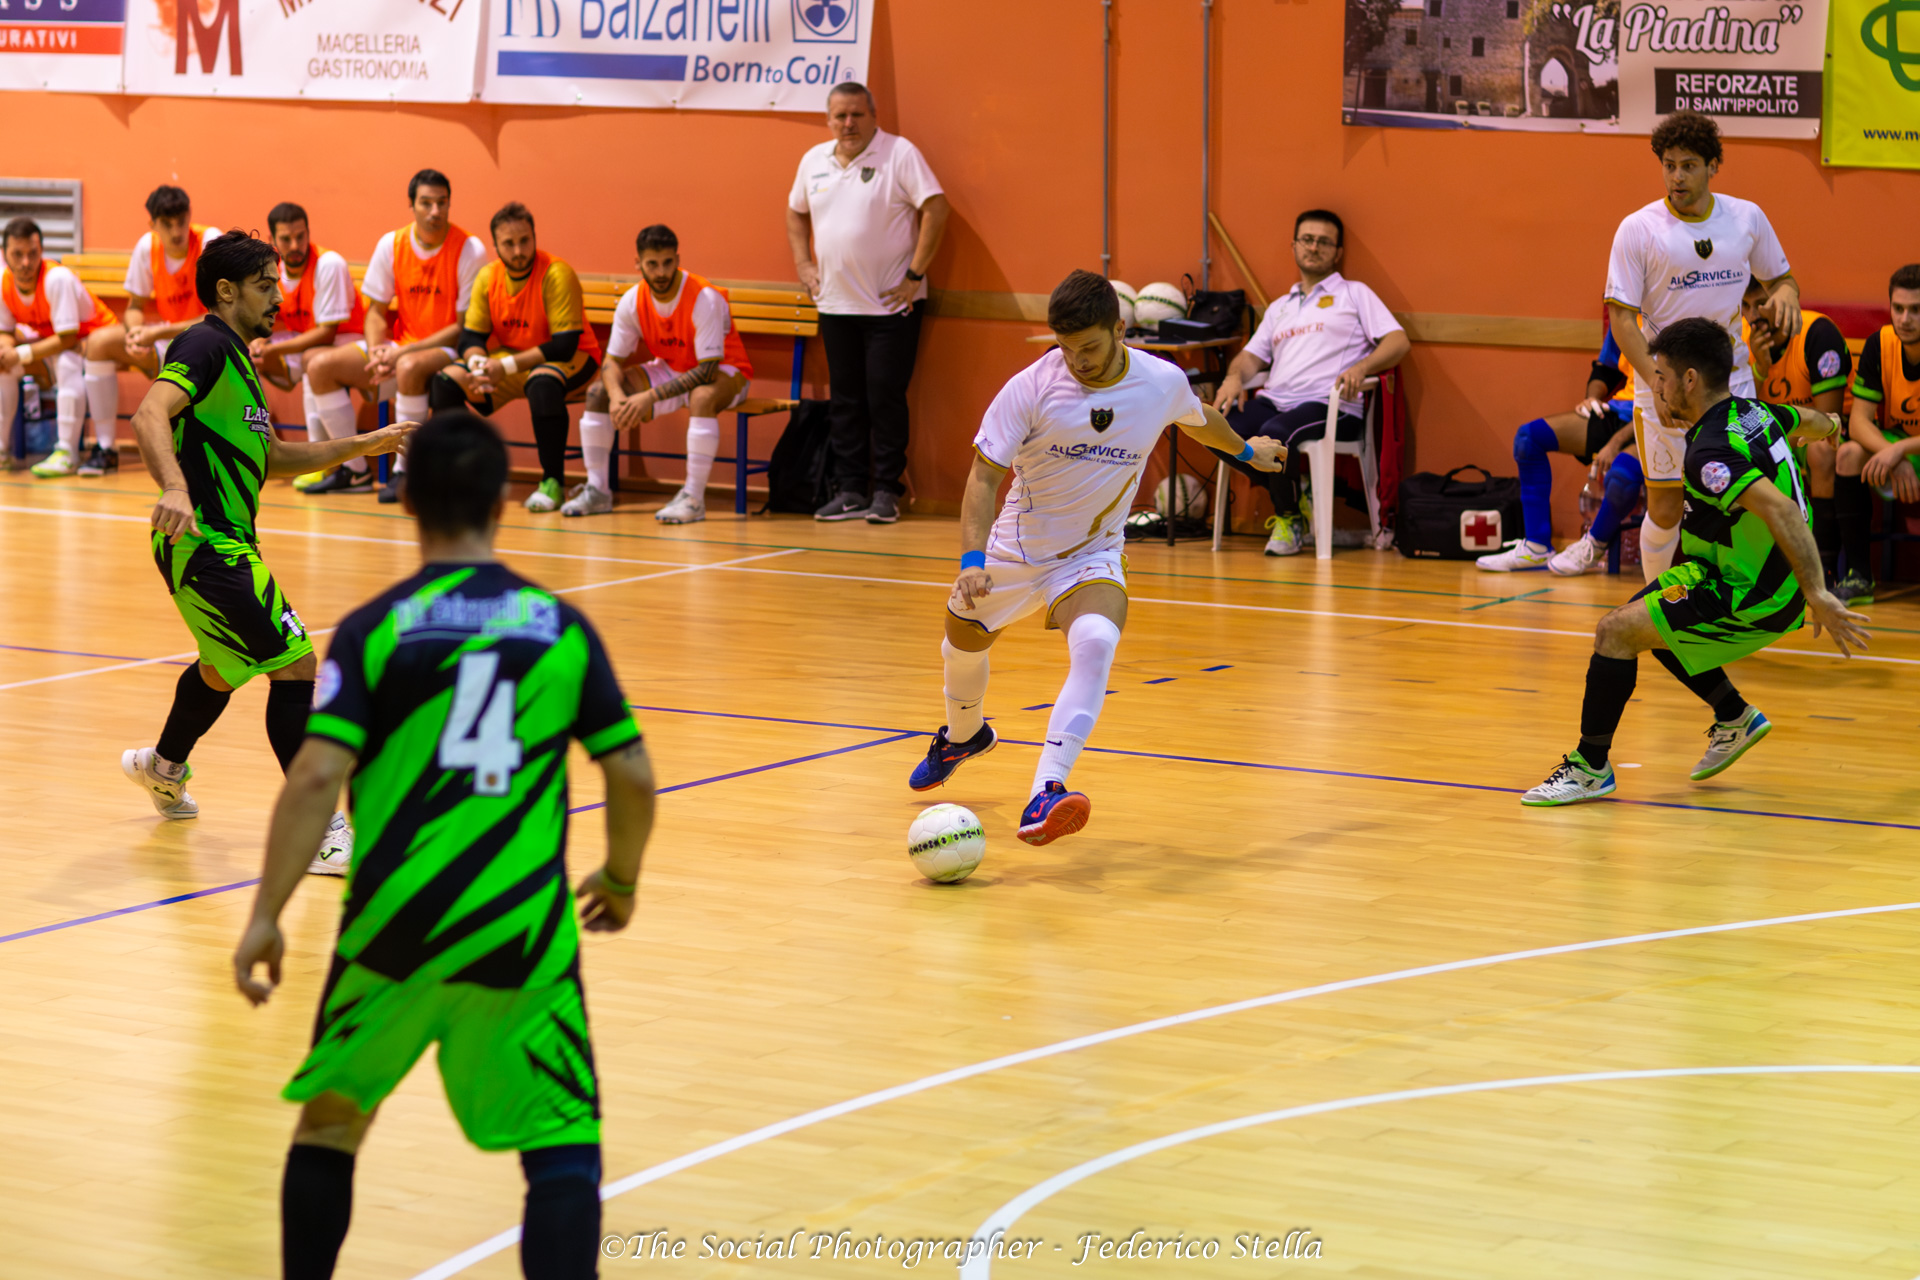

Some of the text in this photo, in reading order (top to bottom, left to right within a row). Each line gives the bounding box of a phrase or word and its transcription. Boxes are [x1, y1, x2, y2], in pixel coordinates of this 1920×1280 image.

[317, 33, 421, 54] MACELLERIA
[307, 58, 429, 80] GASTRONOMIA
[1675, 74, 1798, 95] REFORZATE
[1675, 97, 1799, 114] DI SANT'IPPOLITO
[1863, 129, 1920, 141] www.m
[438, 651, 523, 796] 4
